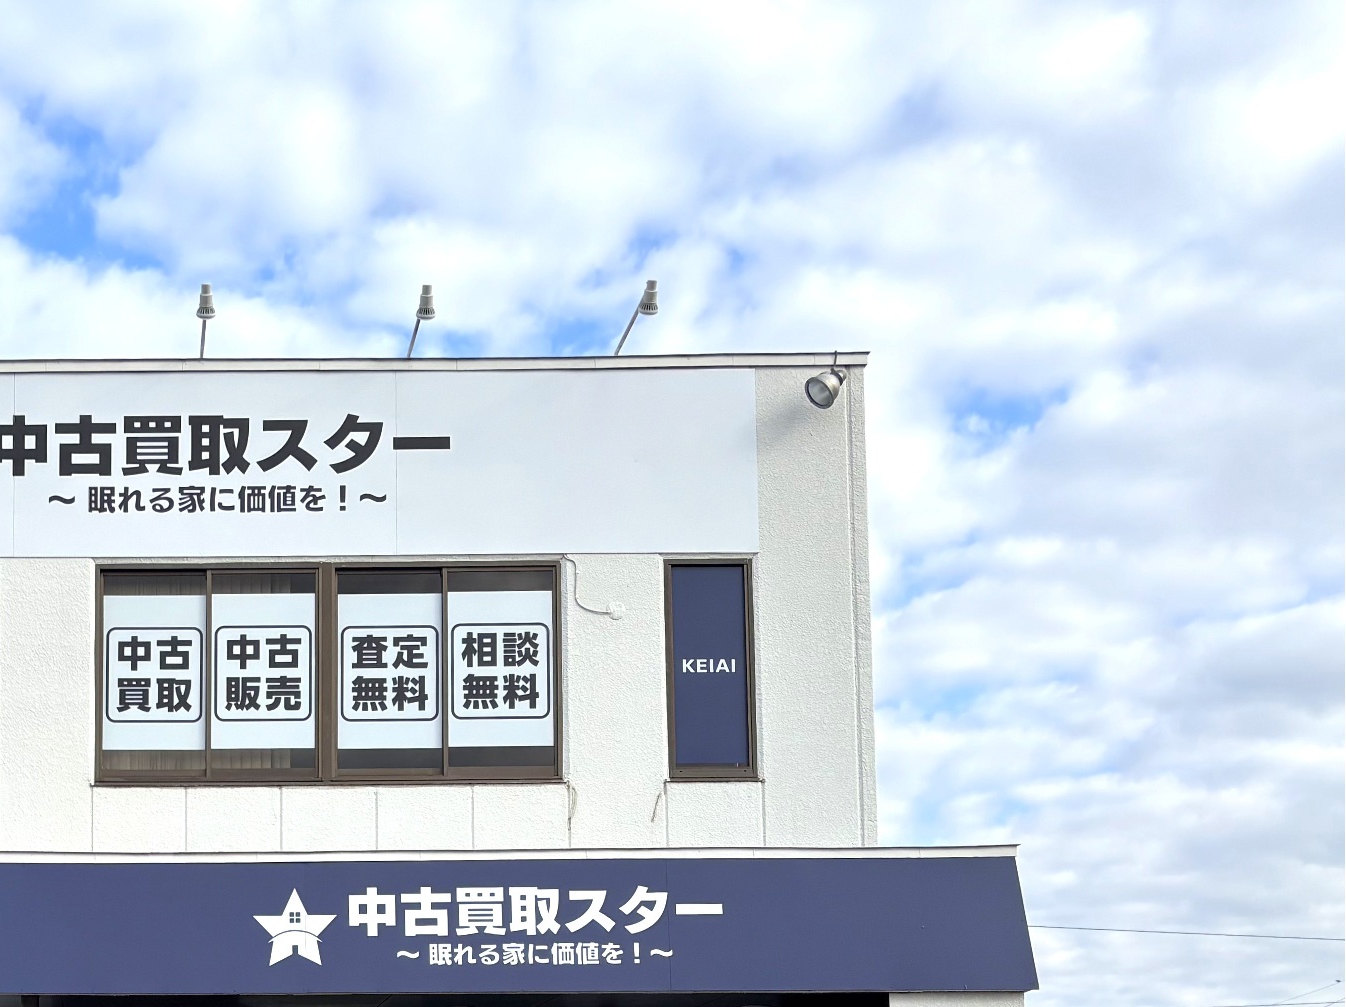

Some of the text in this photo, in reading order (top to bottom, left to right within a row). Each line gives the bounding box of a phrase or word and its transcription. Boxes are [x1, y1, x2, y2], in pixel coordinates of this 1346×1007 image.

[117, 636, 192, 671] 中古
[226, 634, 302, 670] 中古
[351, 634, 429, 669] 査定
[461, 632, 540, 668] 相談
[682, 658, 736, 673] KEIAI
[117, 678, 192, 713] 買取
[225, 676, 302, 712] 販売
[351, 676, 429, 712] 無料
[462, 673, 540, 710] 無料
[348, 885, 724, 937] 中古買取スター
